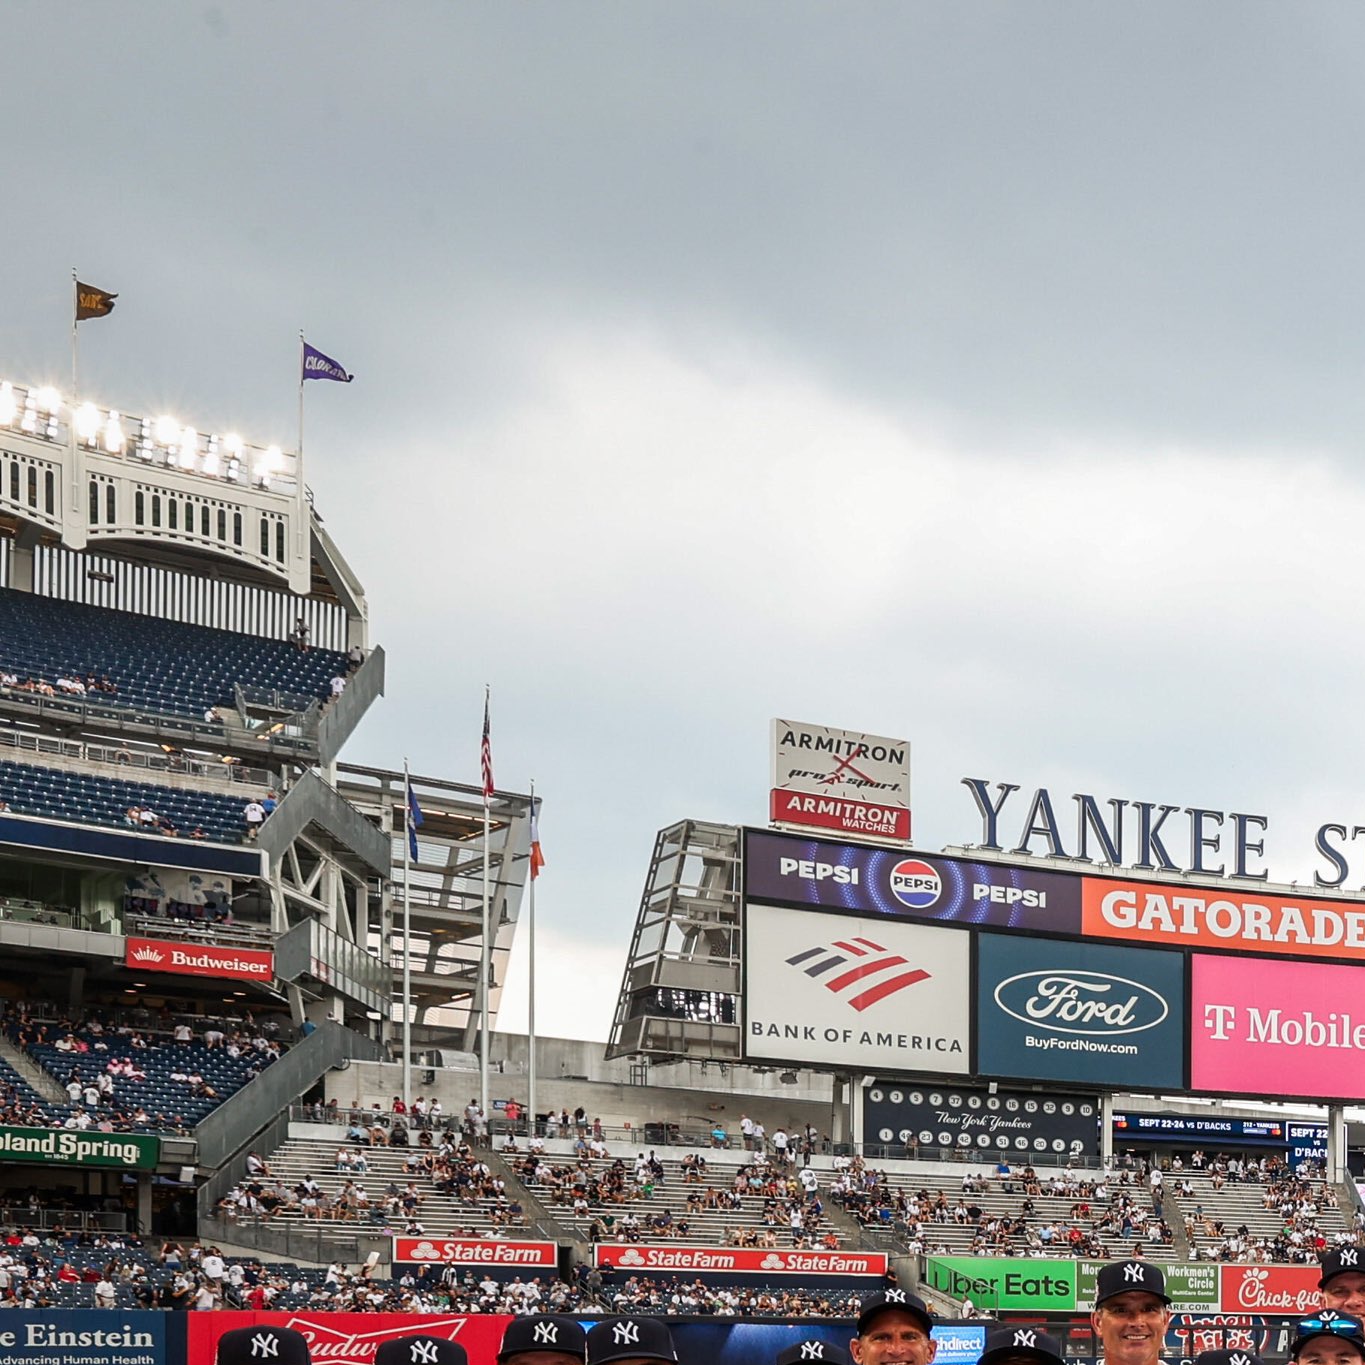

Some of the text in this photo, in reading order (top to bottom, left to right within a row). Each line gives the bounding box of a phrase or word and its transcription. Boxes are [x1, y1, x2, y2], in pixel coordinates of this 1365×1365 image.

[780, 730, 904, 765] ARMITRON
[788, 769, 830, 781] pro
[787, 796, 897, 824] ARMITRON
[842, 818, 896, 834] WATCHES
[961, 777, 1269, 882] YANKEE
[780, 857, 859, 885] PEPSI
[894, 876, 938, 891] PEPSI
[973, 883, 1046, 908] PEPSI
[172, 950, 268, 973] Budweiser
[1025, 976, 1139, 1026] Ford
[751, 1021, 963, 1054] BANK OF AMERICA
[1025, 1035, 1138, 1055] BuyFordNow.com
[935, 1111, 1032, 1131] New York Yankees
[1139, 1118, 1231, 1131] SEPT 22-24 D'BACKS
[1291, 1128, 1315, 1138] SEPT
[58, 1133, 137, 1164] Spring
[932, 1267, 1070, 1296] Uber Eats
[1123, 1262, 1145, 1283] NY
[1167, 1266, 1215, 1277] Workmen's
[1188, 1277, 1215, 1289] Circle
[24, 1324, 154, 1347] Einstein
[612, 1320, 640, 1345] NY
[1013, 1328, 1036, 1348] NY
[252, 1332, 279, 1358] NY
[410, 1340, 439, 1364] NY
[63, 1356, 109, 1365] Human
[112, 1356, 154, 1365] Health
